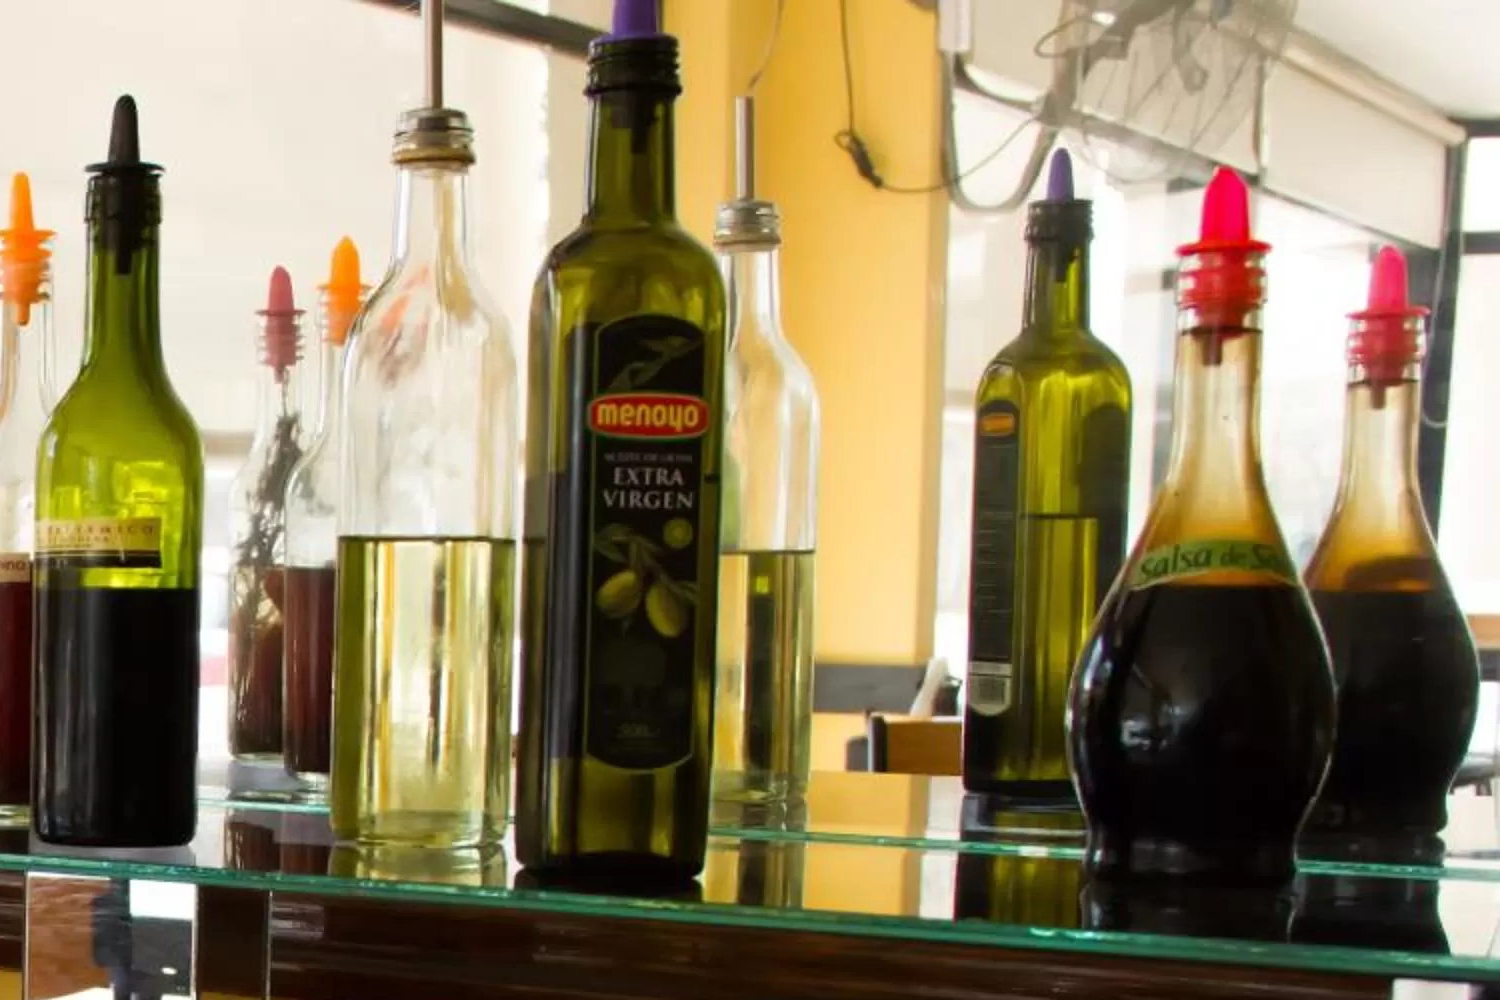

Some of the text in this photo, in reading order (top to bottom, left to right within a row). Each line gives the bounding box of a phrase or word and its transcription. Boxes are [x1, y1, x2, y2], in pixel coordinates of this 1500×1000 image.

[597, 402, 699, 432] menoyo
[613, 466, 685, 487] EXTRA
[602, 489, 694, 510] VIRGEN
[1220, 545, 1249, 566] de
